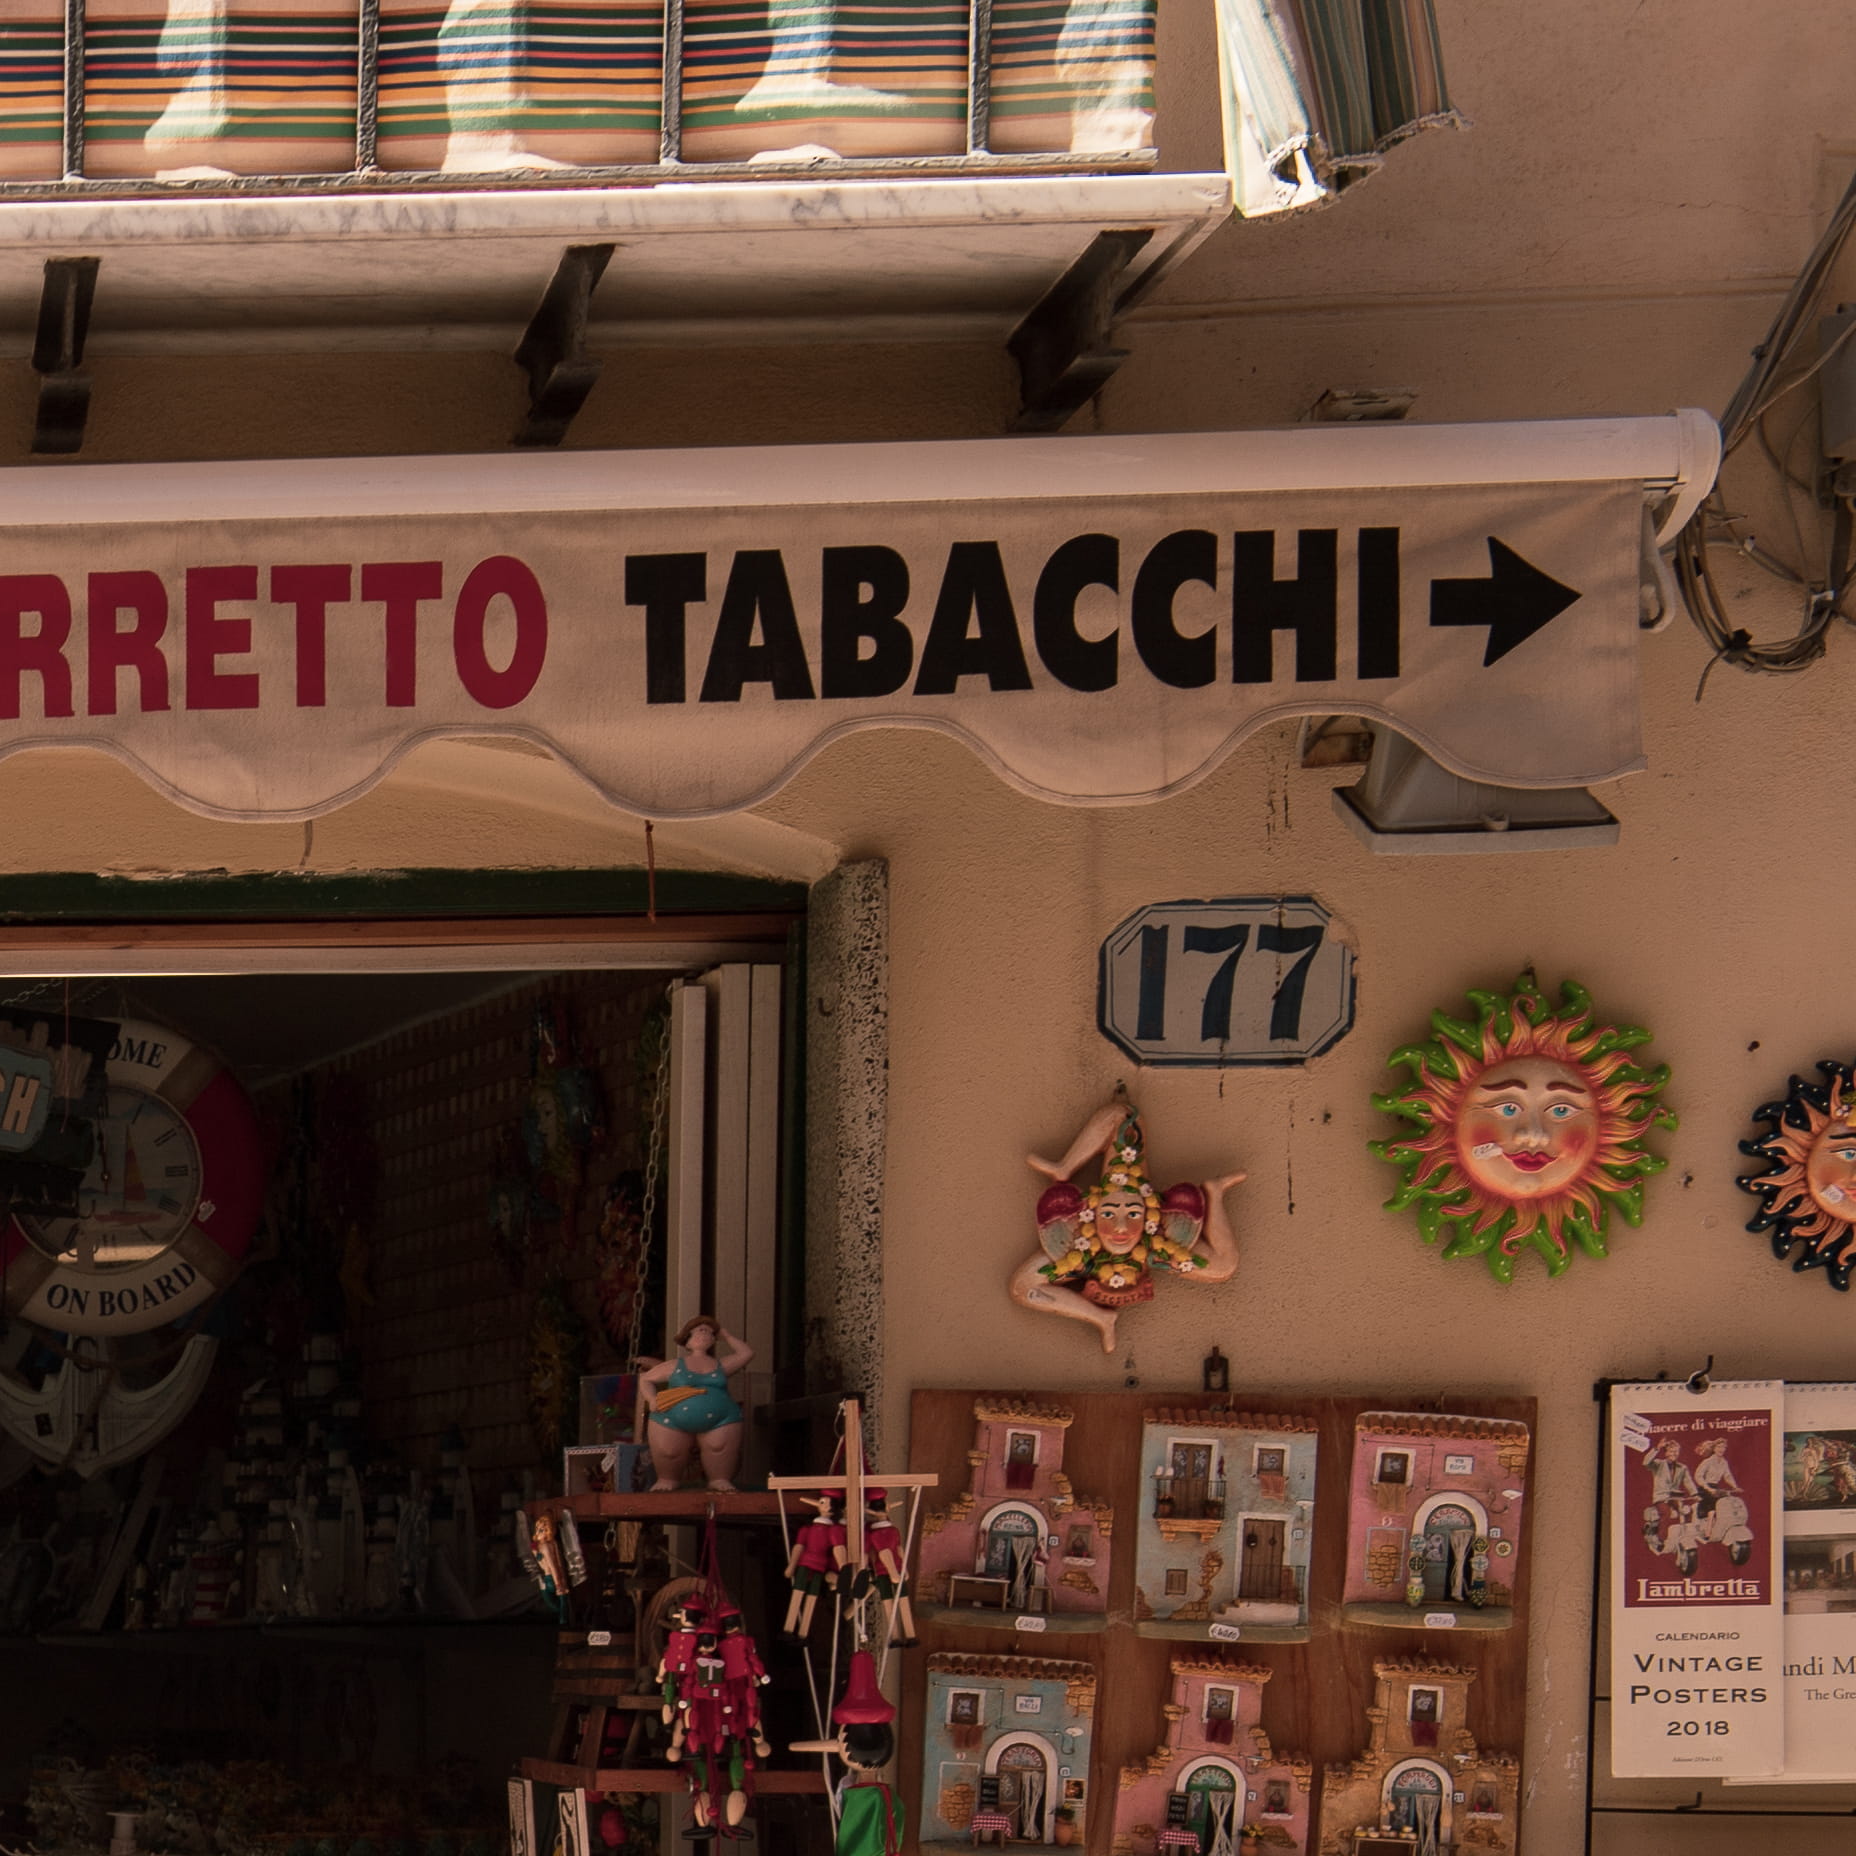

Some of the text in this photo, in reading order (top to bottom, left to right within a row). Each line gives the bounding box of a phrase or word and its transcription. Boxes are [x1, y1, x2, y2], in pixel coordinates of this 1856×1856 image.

[624, 525, 1401, 707] TABACCHI
[1136, 922, 1328, 1042] 177
[47, 1261, 197, 1318] ON BOARD
[1646, 1416, 1769, 1434] iacere di viaggiare
[1637, 1577, 1761, 1602] Lambretta
[1655, 1631, 1741, 1641] CALENDARIO
[1633, 1653, 1764, 1673] VINTAGE
[1630, 1685, 1767, 1705] POSTERS
[1804, 1688, 1830, 1701] The
[1666, 1720, 1730, 1737] 2018
